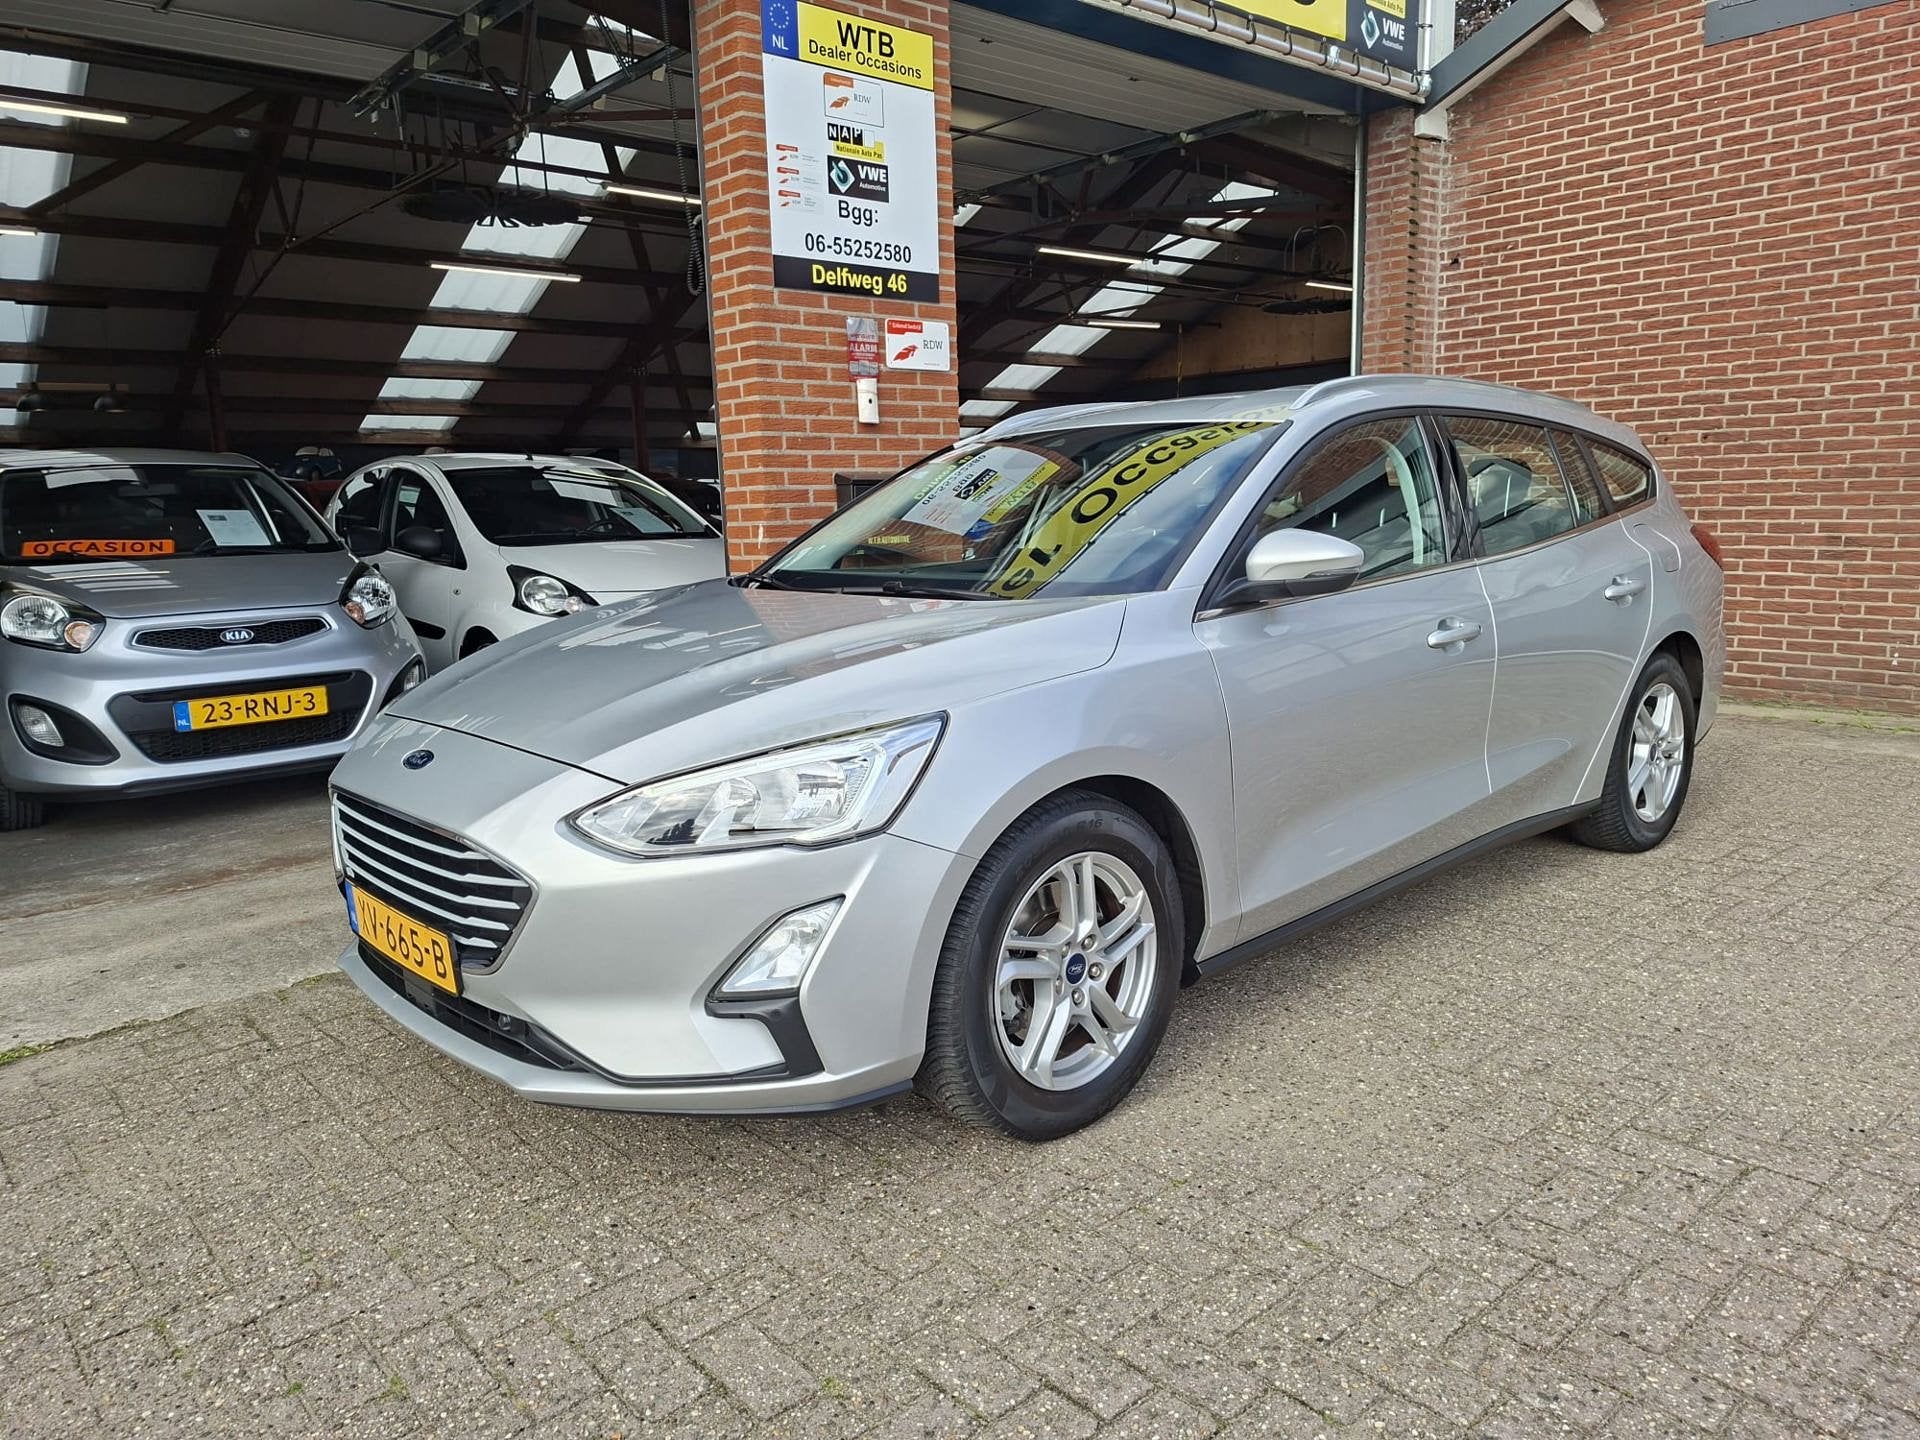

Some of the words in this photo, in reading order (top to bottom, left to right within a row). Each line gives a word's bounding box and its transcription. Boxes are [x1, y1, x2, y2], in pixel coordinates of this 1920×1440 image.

[1382, 17, 1405, 41] VWE
[772, 34, 789, 51] NL
[837, 19, 895, 58] WTB
[808, 39, 852, 62] Dealer
[856, 51, 922, 80] Occasions
[853, 92, 872, 104] RDW
[829, 125, 861, 140] NAP
[857, 164, 887, 183] VWE
[859, 181, 887, 192] Automotive
[837, 199, 880, 227] Bgg:
[804, 232, 913, 264] 06-55252580
[812, 264, 883, 295] Delfweg
[887, 273, 908, 293] 46
[849, 343, 878, 353] ALARM
[923, 339, 943, 350] RDW
[33, 541, 164, 555] OCCASION
[225, 630, 249, 642] KIA
[202, 692, 316, 724] 23-RNJ-3
[177, 719, 190, 728] NL
[358, 895, 447, 980] XV-665-B
